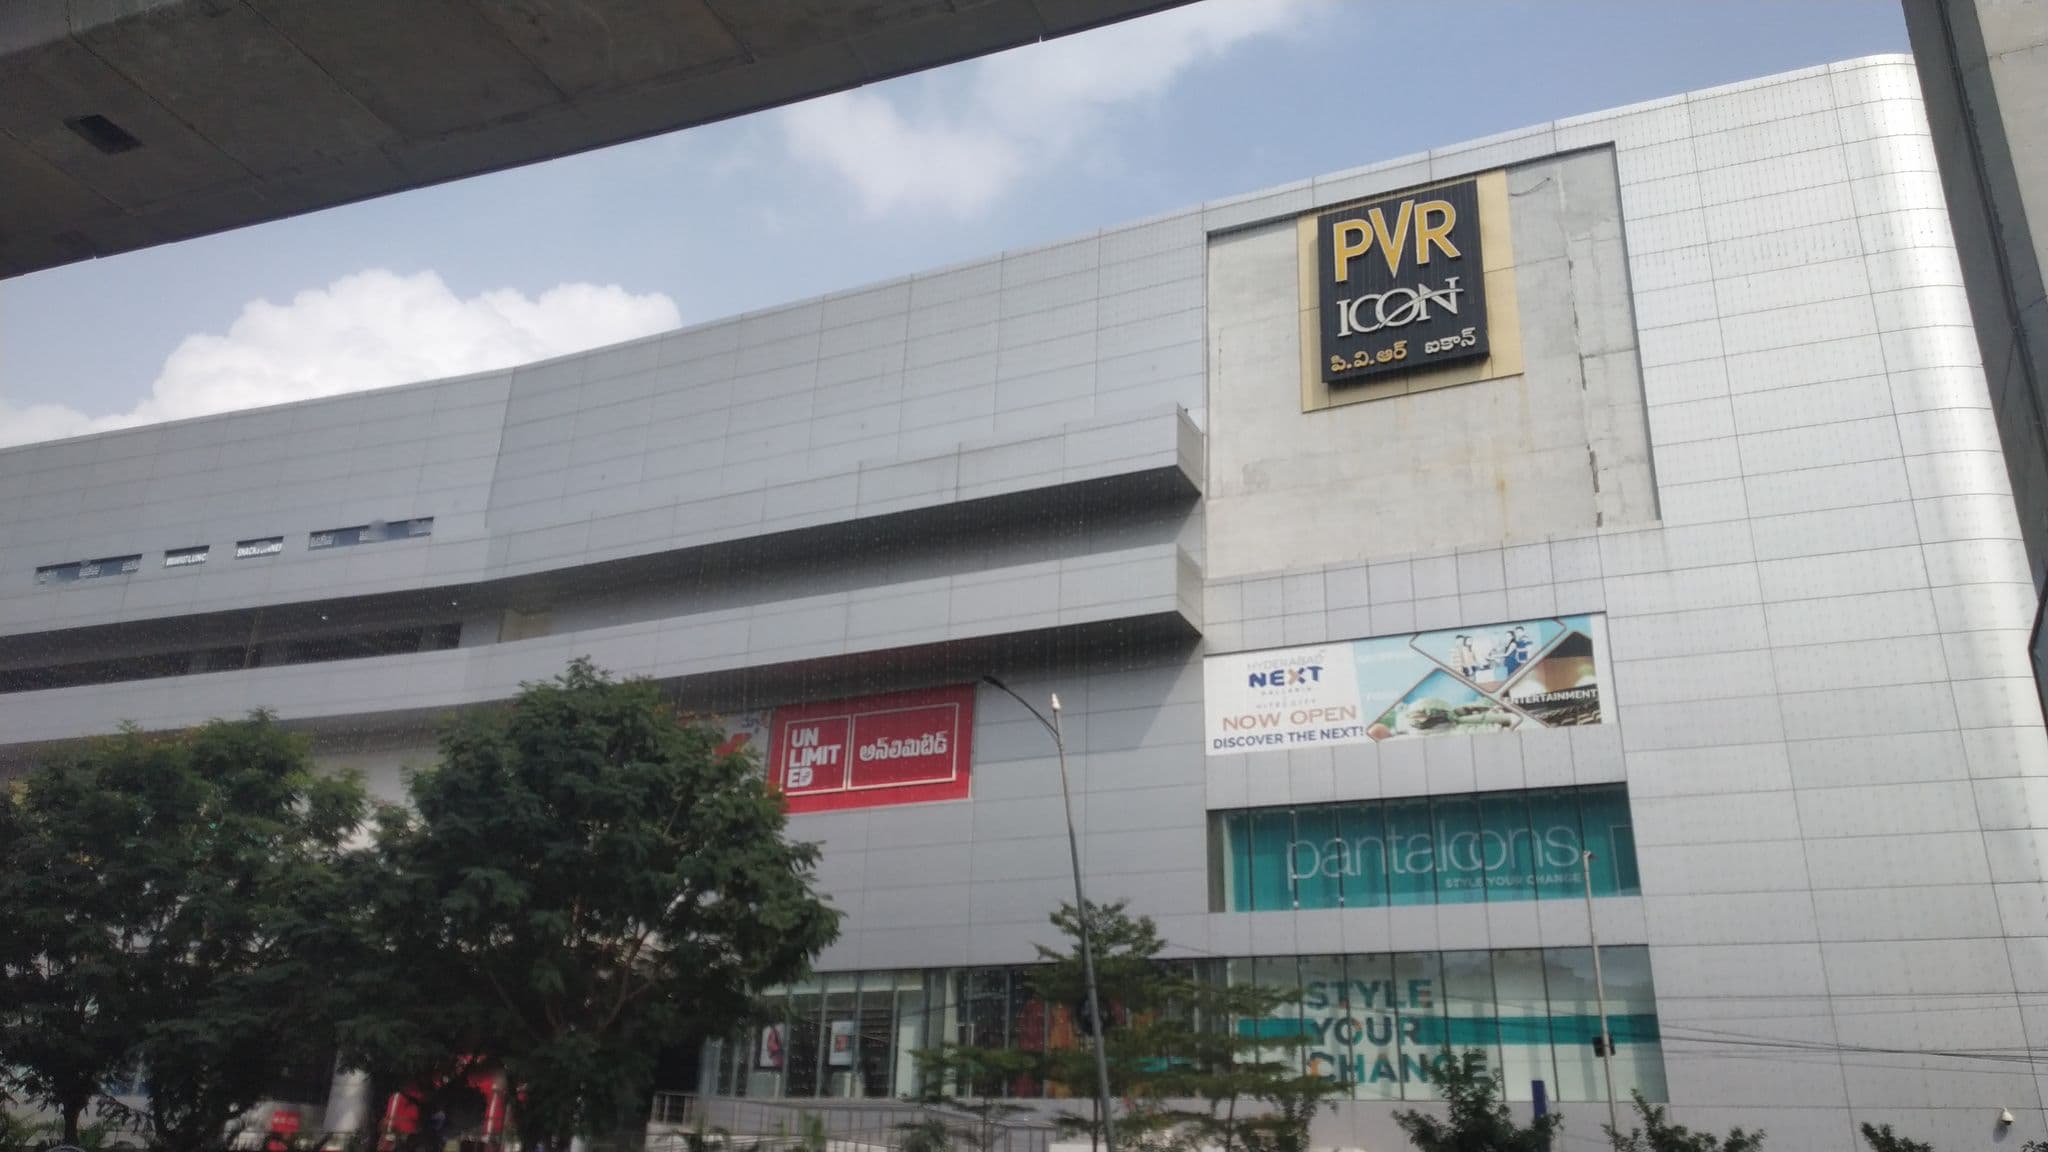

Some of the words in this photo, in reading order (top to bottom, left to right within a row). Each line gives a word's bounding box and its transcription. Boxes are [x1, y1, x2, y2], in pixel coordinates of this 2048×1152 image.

[1333, 199, 1462, 283] PVR
[1336, 276, 1464, 337] ICON
[1424, 327, 1476, 355] ఐకాన్
[1248, 665, 1324, 688] NEXT
[1222, 712, 1282, 732] NOW
[1290, 705, 1357, 726] OPEN
[791, 727, 819, 747] UN
[1213, 733, 1283, 749] DISCOVER
[1288, 730, 1317, 743] THE
[1320, 726, 1364, 740] NEXT!
[789, 744, 841, 769] LIMIT
[787, 766, 813, 788] ED
[1287, 820, 1580, 891] pantaloons
[1445, 878, 1483, 889] STYLE
[1526, 873, 1582, 885] CHANGE
[1306, 979, 1434, 1010] STYLE
[1310, 1016, 1422, 1046] YOUR
